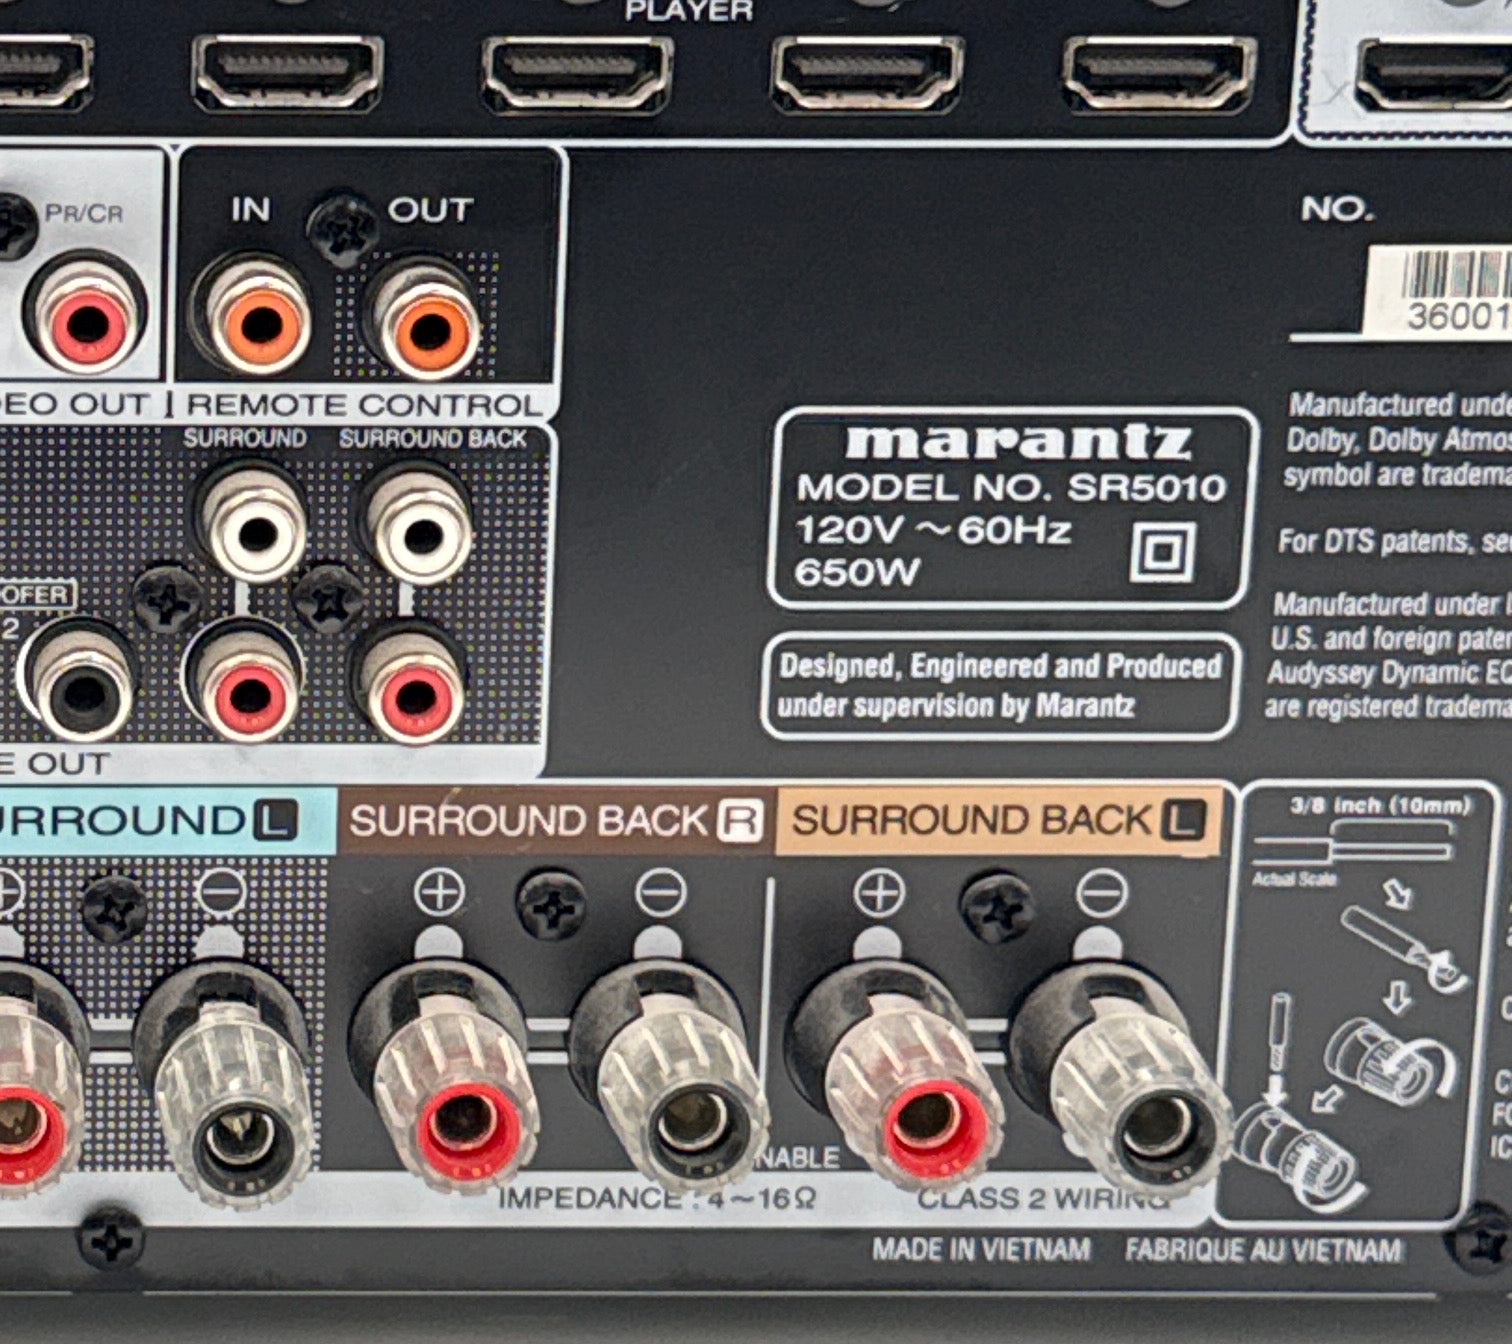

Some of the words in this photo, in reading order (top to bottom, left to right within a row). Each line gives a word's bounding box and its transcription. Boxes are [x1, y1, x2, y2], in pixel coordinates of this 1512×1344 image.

[44, 202, 123, 224] PR/CR
[232, 196, 270, 222] IN
[387, 196, 475, 223] OUT
[1301, 195, 1374, 222] NO.
[1407, 301, 1510, 331] 36001
[69, 392, 151, 416] OUT
[187, 393, 347, 417] REMOTE
[358, 393, 544, 418] CONTROL
[1289, 391, 1456, 418] Manufactured
[182, 427, 308, 449] SURROUND
[339, 427, 464, 449] SURROUND
[468, 427, 528, 449] BACK
[845, 422, 1192, 461] marantz
[1368, 425, 1439, 457] Dolby
[797, 472, 960, 502] MODEL
[973, 473, 1052, 502] NO.
[1067, 472, 1227, 502] SR5010
[1283, 461, 1372, 492] symbol
[1376, 466, 1417, 487] are
[796, 514, 906, 545] 120V
[1278, 527, 1319, 554] For
[1324, 527, 1376, 554] DTS
[1480, 531, 1512, 555] se
[794, 557, 922, 587] 650W
[1273, 591, 1430, 617] Manufactured
[1434, 592, 1502, 617] under
[1, 617, 20, 640] 2
[1271, 624, 1318, 651] U.S.
[1323, 625, 1368, 651] and
[1373, 625, 1453, 656] foreign
[779, 651, 903, 684] Designed,
[910, 651, 1049, 684] Engineered
[1054, 652, 1101, 679] and
[1106, 652, 1223, 679] Produced
[1266, 659, 1378, 690] Audyssey
[1382, 658, 1481, 690] Dynamic
[777, 691, 849, 718] under
[853, 692, 995, 723] supervision
[1000, 692, 1031, 724] by
[1036, 691, 1136, 718] Marantz
[1264, 698, 1302, 718] are
[1307, 693, 1420, 724] registered
[27, 751, 111, 776] OUT
[1290, 796, 1326, 815] 3/8
[1388, 795, 1473, 816] (10mm)
[258, 801, 292, 839] L
[350, 801, 587, 837] SURROUND
[598, 804, 709, 837] BACK
[720, 801, 761, 839] R
[792, 803, 1030, 836] SURROUND
[1041, 803, 1153, 836] BACK
[1165, 801, 1200, 839] L
[498, 1186, 683, 1211] IMPEDANCE
[916, 1186, 1021, 1211] CLASS
[1028, 1187, 1047, 1210] 2
[872, 1236, 943, 1262] MADE
[950, 1237, 976, 1262] IN
[981, 1236, 1092, 1262] VIETNAM
[1125, 1236, 1246, 1263] FABRIQUE
[1250, 1238, 1287, 1263] AU
[1292, 1238, 1403, 1263] VIETNAM
